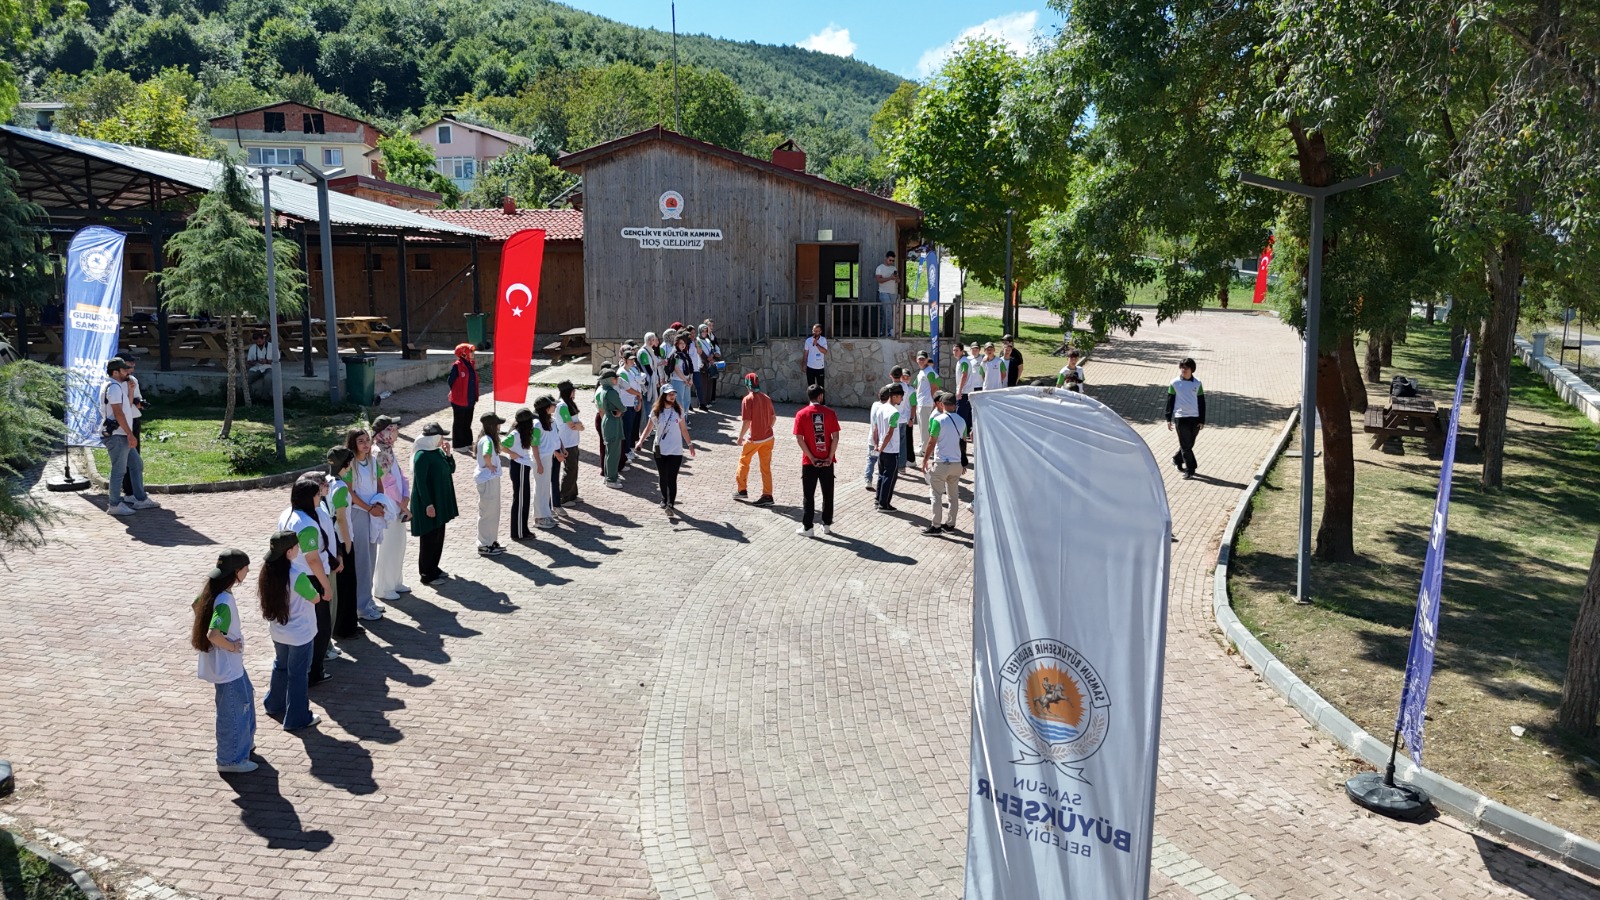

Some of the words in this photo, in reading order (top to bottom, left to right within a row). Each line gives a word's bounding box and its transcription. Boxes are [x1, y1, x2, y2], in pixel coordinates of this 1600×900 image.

[623, 228, 652, 237] GENÇLİK
[663, 229, 689, 237] KÜLTÜR
[642, 238, 661, 247] HOŞ
[75, 320, 113, 332] SAMSUN
